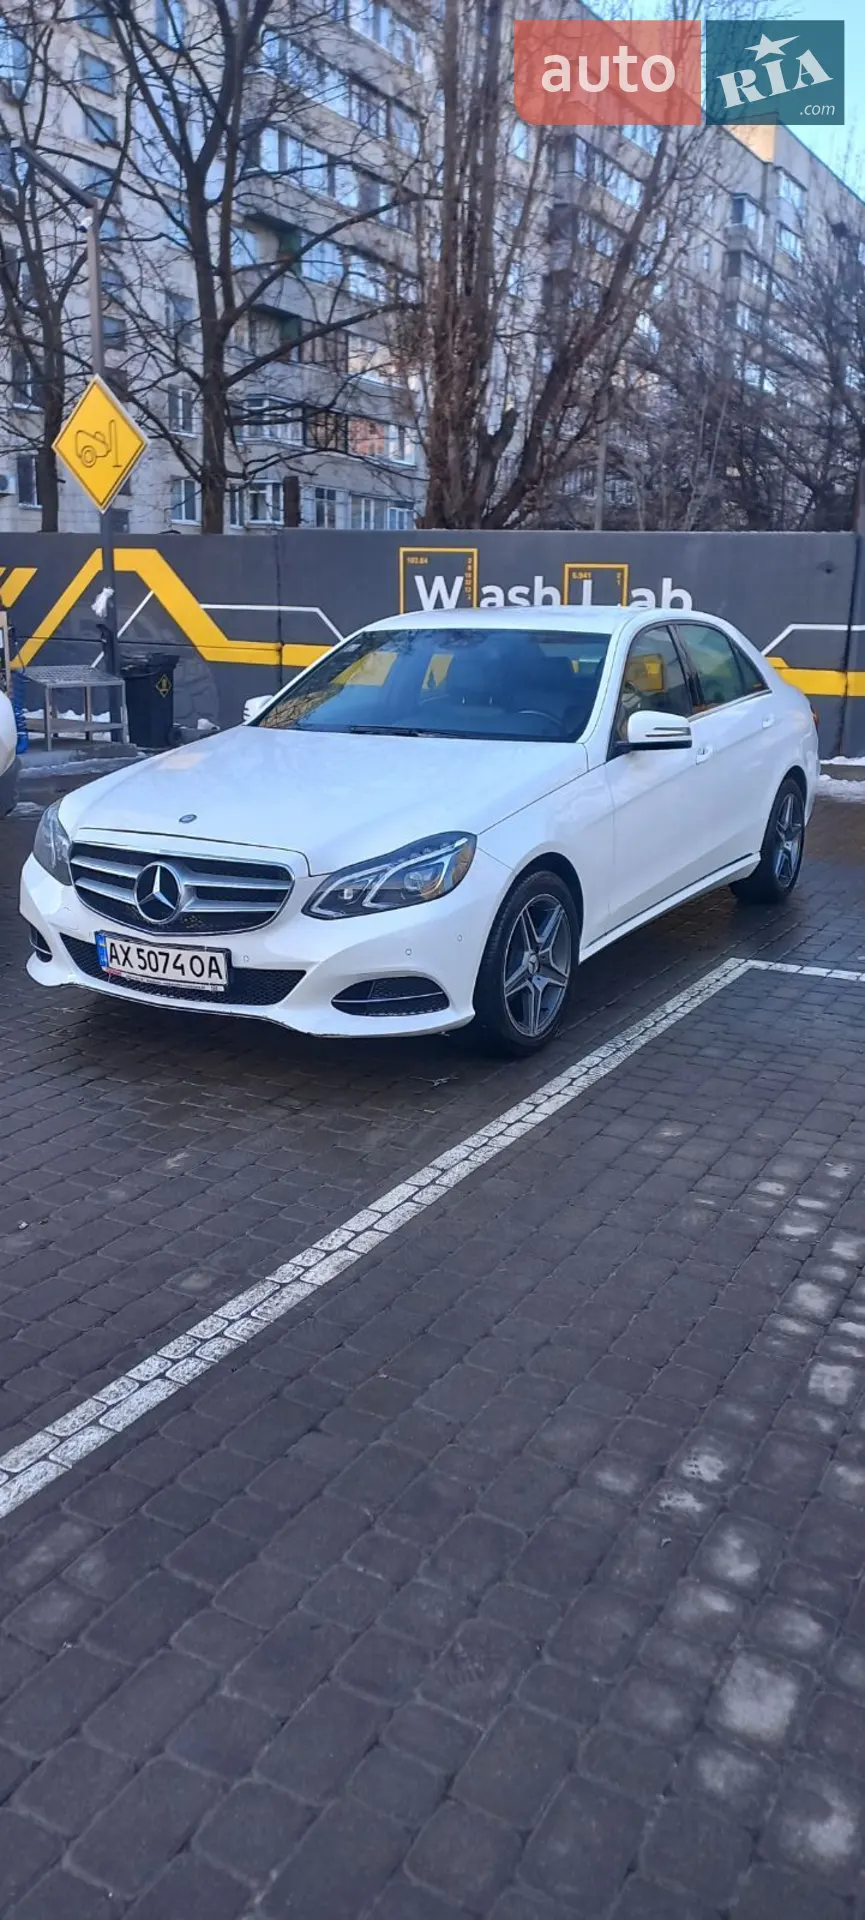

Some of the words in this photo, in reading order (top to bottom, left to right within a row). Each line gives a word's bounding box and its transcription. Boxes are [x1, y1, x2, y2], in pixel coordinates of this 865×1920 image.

[414, 575, 561, 611] Wash
[109, 943, 134, 969] AX
[136, 948, 186, 976] 5074
[189, 955, 223, 979] OA
